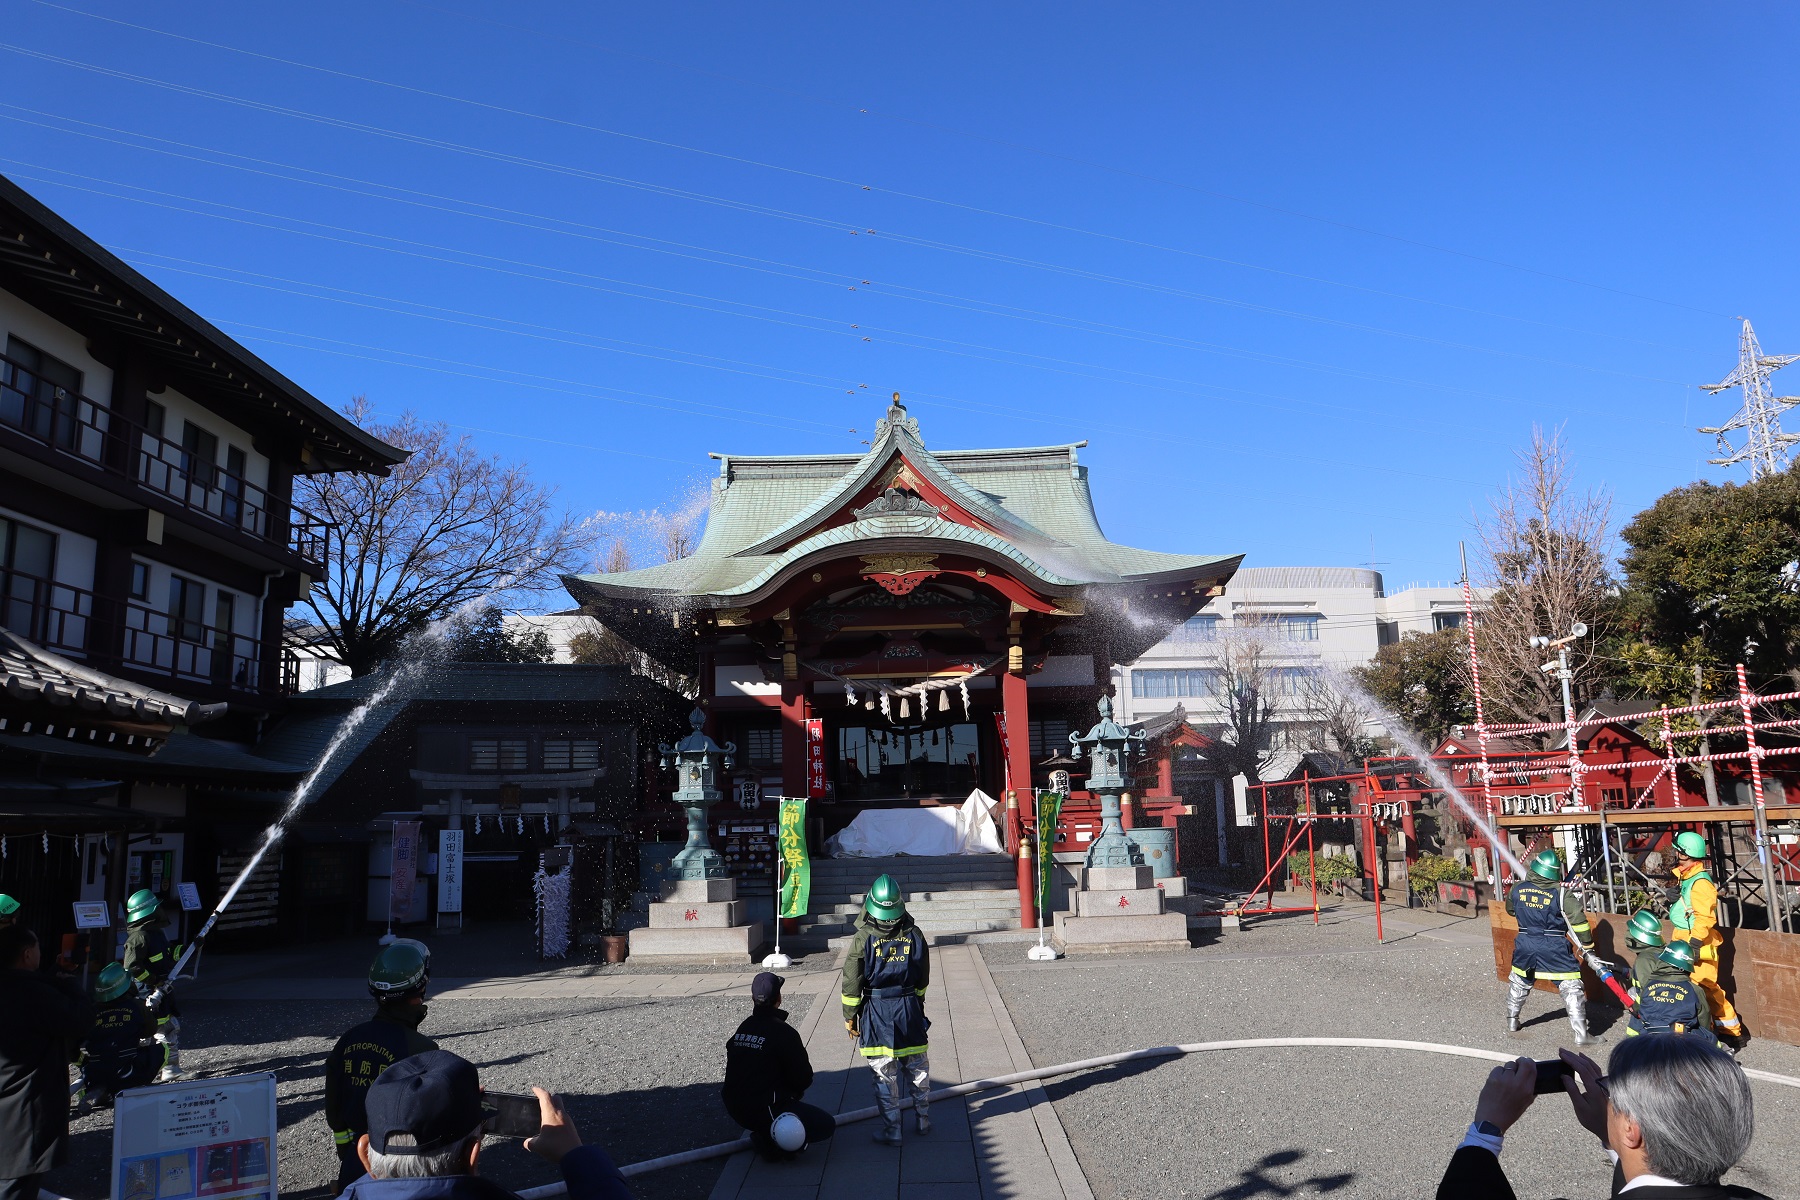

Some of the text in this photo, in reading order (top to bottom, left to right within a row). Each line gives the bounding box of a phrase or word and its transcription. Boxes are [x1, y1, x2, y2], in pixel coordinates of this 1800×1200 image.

[811, 727, 823, 790] 羽田神社
[1040, 795, 1054, 864] 節分祭
[781, 803, 805, 870] 節分祭
[444, 831, 456, 884] 羽田富士塚
[1518, 888, 1554, 899] METROPOLITAN
[1118, 895, 1130, 908] 奉
[1519, 894, 1551, 906] 消防団
[684, 908, 699, 921] 献
[1648, 983, 1689, 995] METROPOLITAN
[1653, 996, 1675, 1004] TOKYO
[733, 1033, 766, 1045] 東京消防庁
[350, 1076, 375, 1087] TOKY
